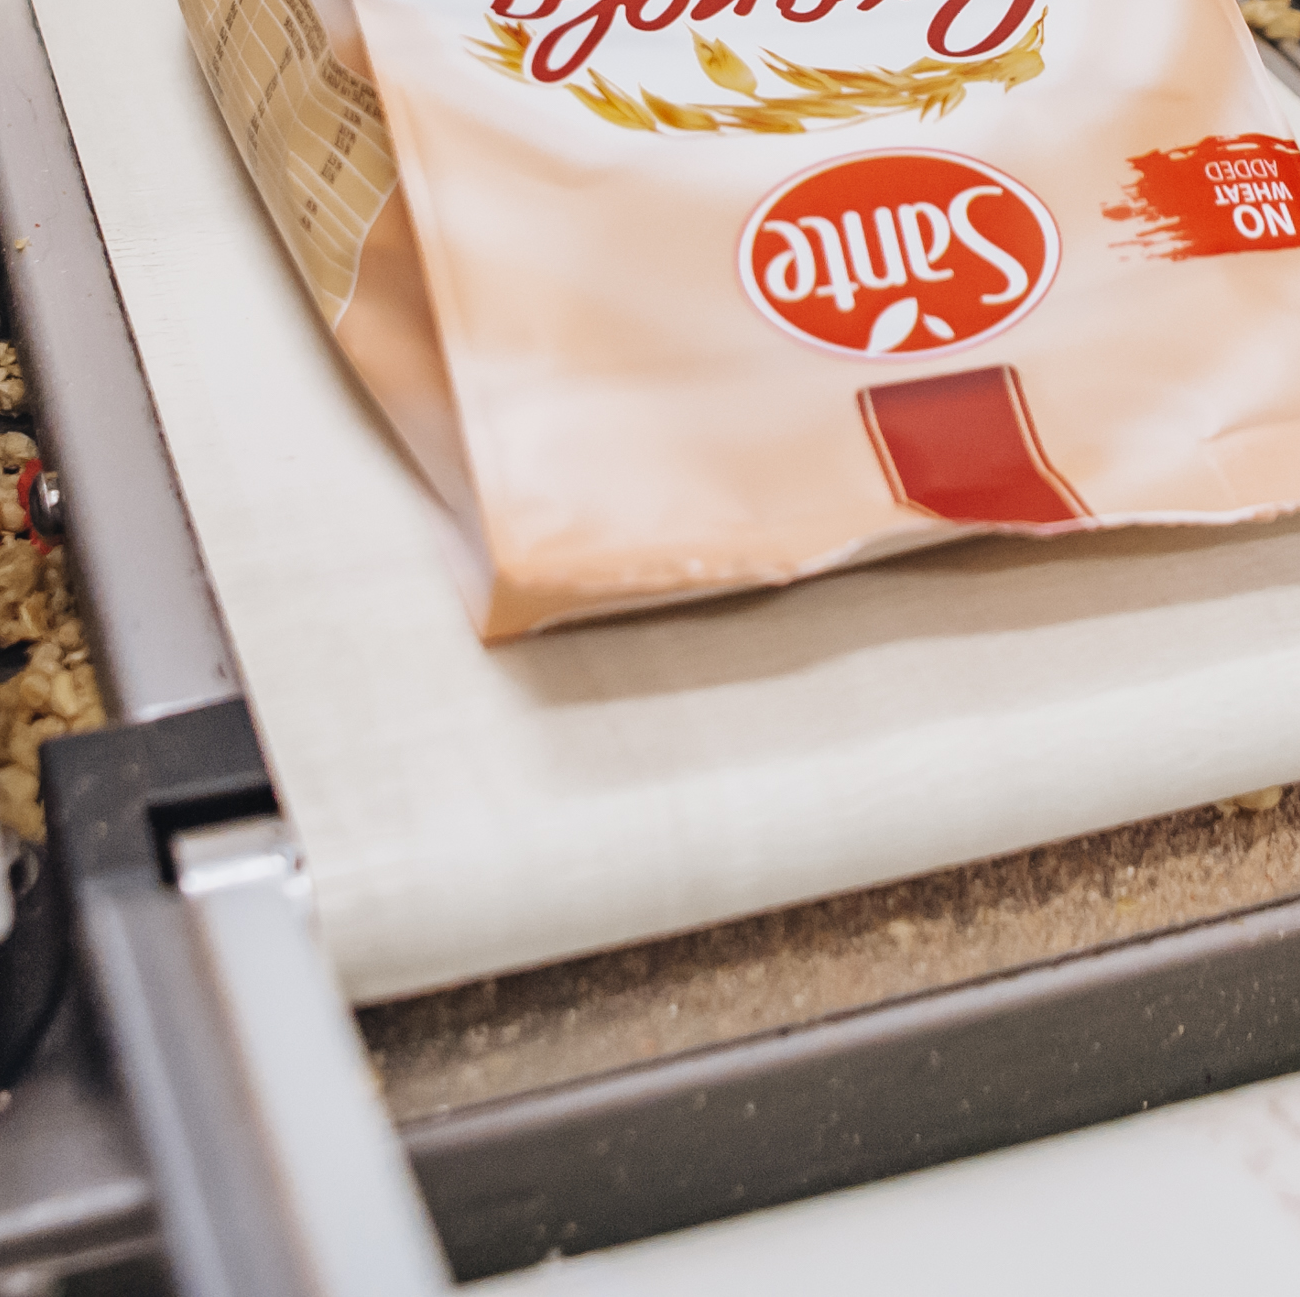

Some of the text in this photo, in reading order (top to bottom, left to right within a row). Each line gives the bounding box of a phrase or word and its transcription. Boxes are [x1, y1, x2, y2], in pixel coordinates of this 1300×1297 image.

[1204, 158, 1279, 181] ADDED
[1214, 181, 1293, 206] WHEAT
[1232, 202, 1297, 239] NO
